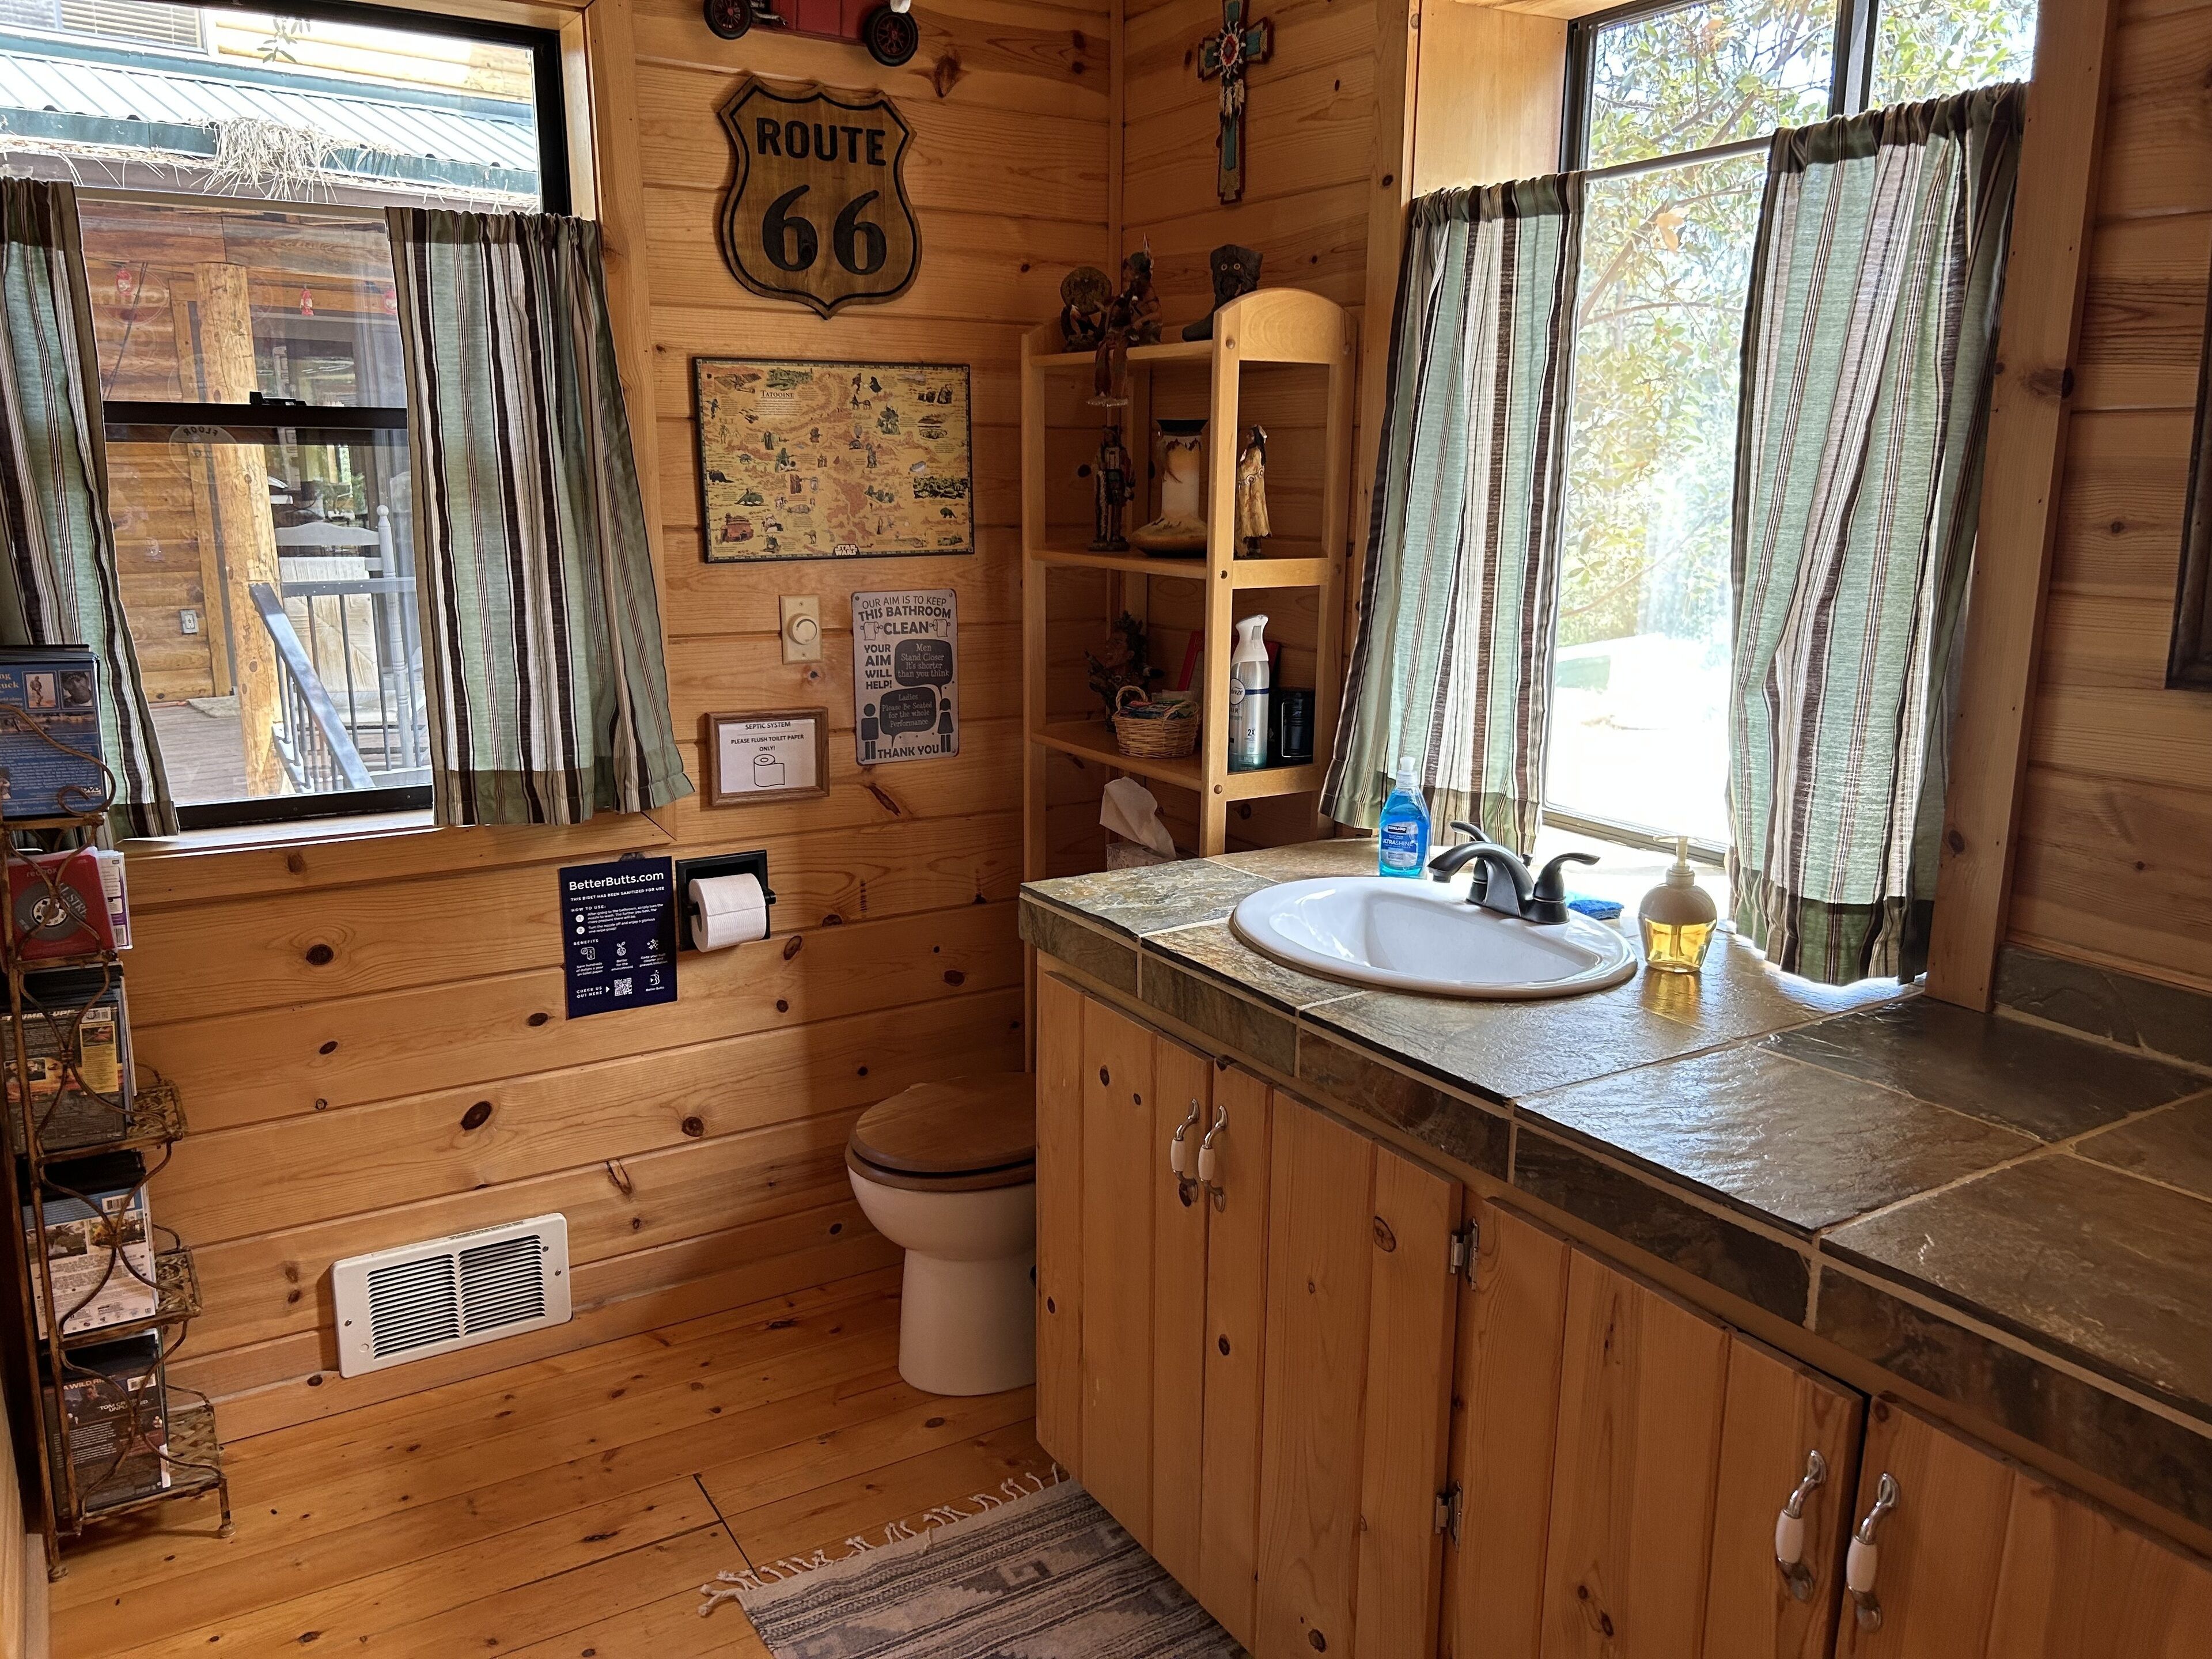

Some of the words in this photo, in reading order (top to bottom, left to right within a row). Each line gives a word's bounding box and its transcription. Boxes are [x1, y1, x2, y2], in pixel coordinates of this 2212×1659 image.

[756, 118, 887, 166] ROUTE
[762, 184, 887, 275] 66
[862, 599, 881, 609] OUR
[884, 596, 899, 605] AIM
[903, 596, 910, 604] IS
[914, 596, 923, 604] TO
[927, 597, 946, 607] KEEP
[858, 608, 882, 621] THIS
[886, 606, 951, 619] BATHROOM
[884, 622, 929, 635] CLEAN
[864, 645, 891, 653] YOUR
[916, 643, 931, 652] Men
[865, 655, 891, 666] AIM
[923, 653, 944, 661] Closer
[865, 669, 892, 678] WILL
[866, 680, 892, 690] HELP!
[890, 719, 929, 728] Performance
[878, 747, 915, 759] THANK
[918, 744, 939, 755] YOU
[26, 868, 57, 877] reox
[569, 873, 664, 891] BetterButts.com
[69, 1380, 92, 1389] WILD
